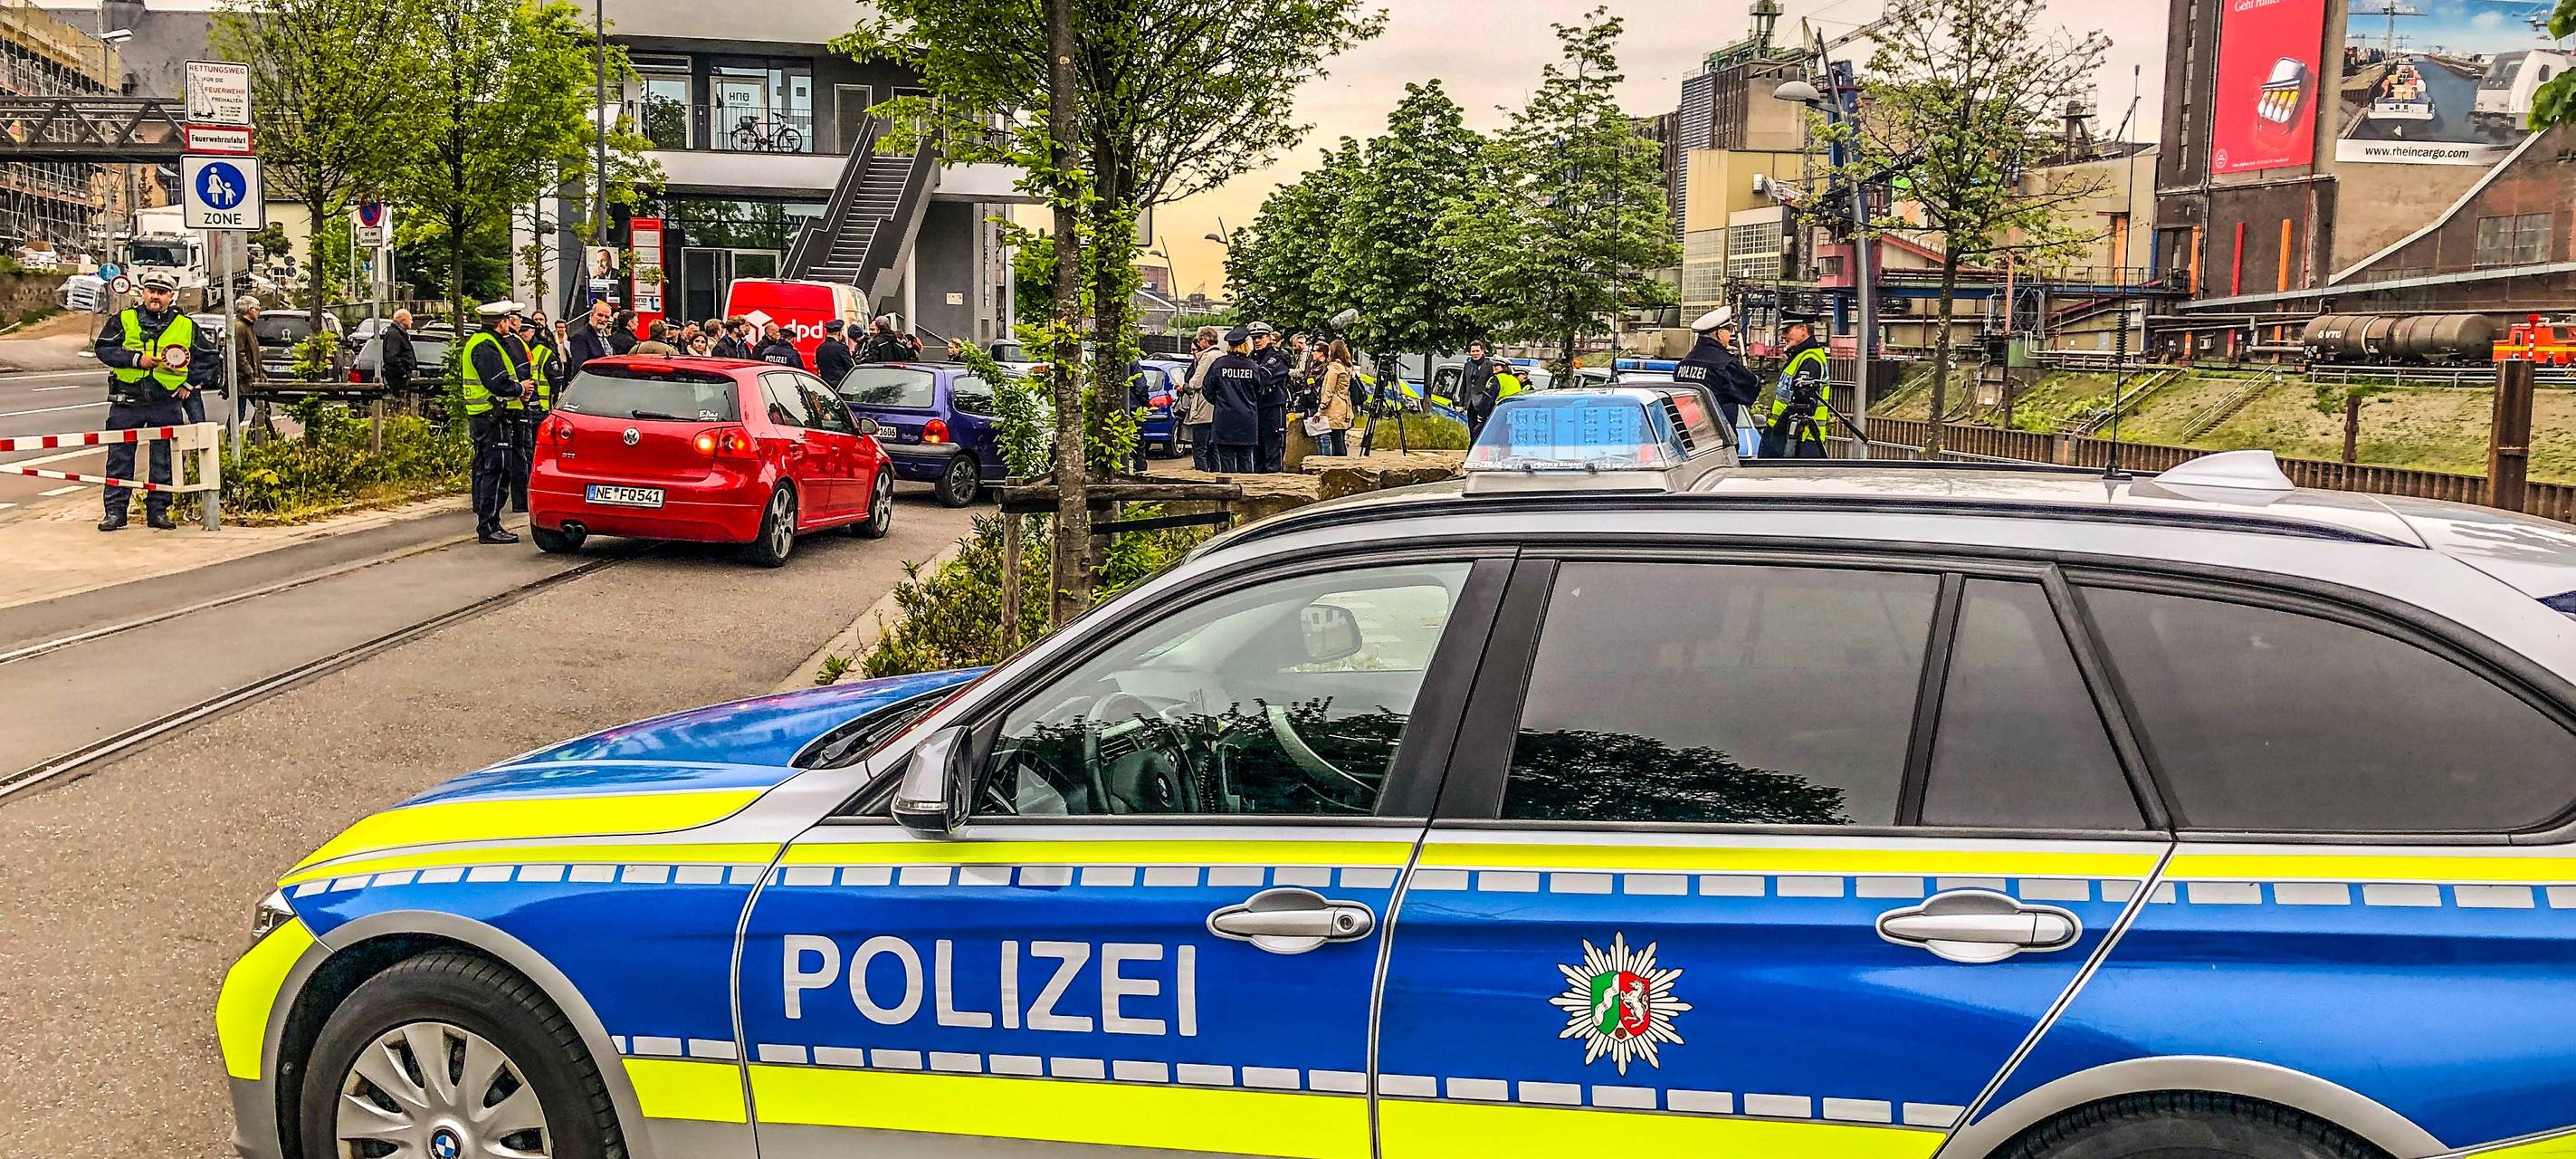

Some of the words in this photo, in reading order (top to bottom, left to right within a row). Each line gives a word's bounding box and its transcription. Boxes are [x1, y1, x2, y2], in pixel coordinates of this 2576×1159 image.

[188, 65, 245, 74] RETTUNGSWEG
[191, 134, 246, 144] Feuerwehrzufahrt
[2365, 147, 2469, 159] www.rheincargo.com
[204, 213, 243, 225] ZONE
[2325, 330, 2342, 339] VTG
[765, 355, 787, 364] POLIZEI
[1222, 368, 1253, 378] POLIZEI
[1676, 365, 1707, 380] POLIZEI
[596, 486, 613, 500] NE
[783, 934, 1197, 1037] POLIZEI
